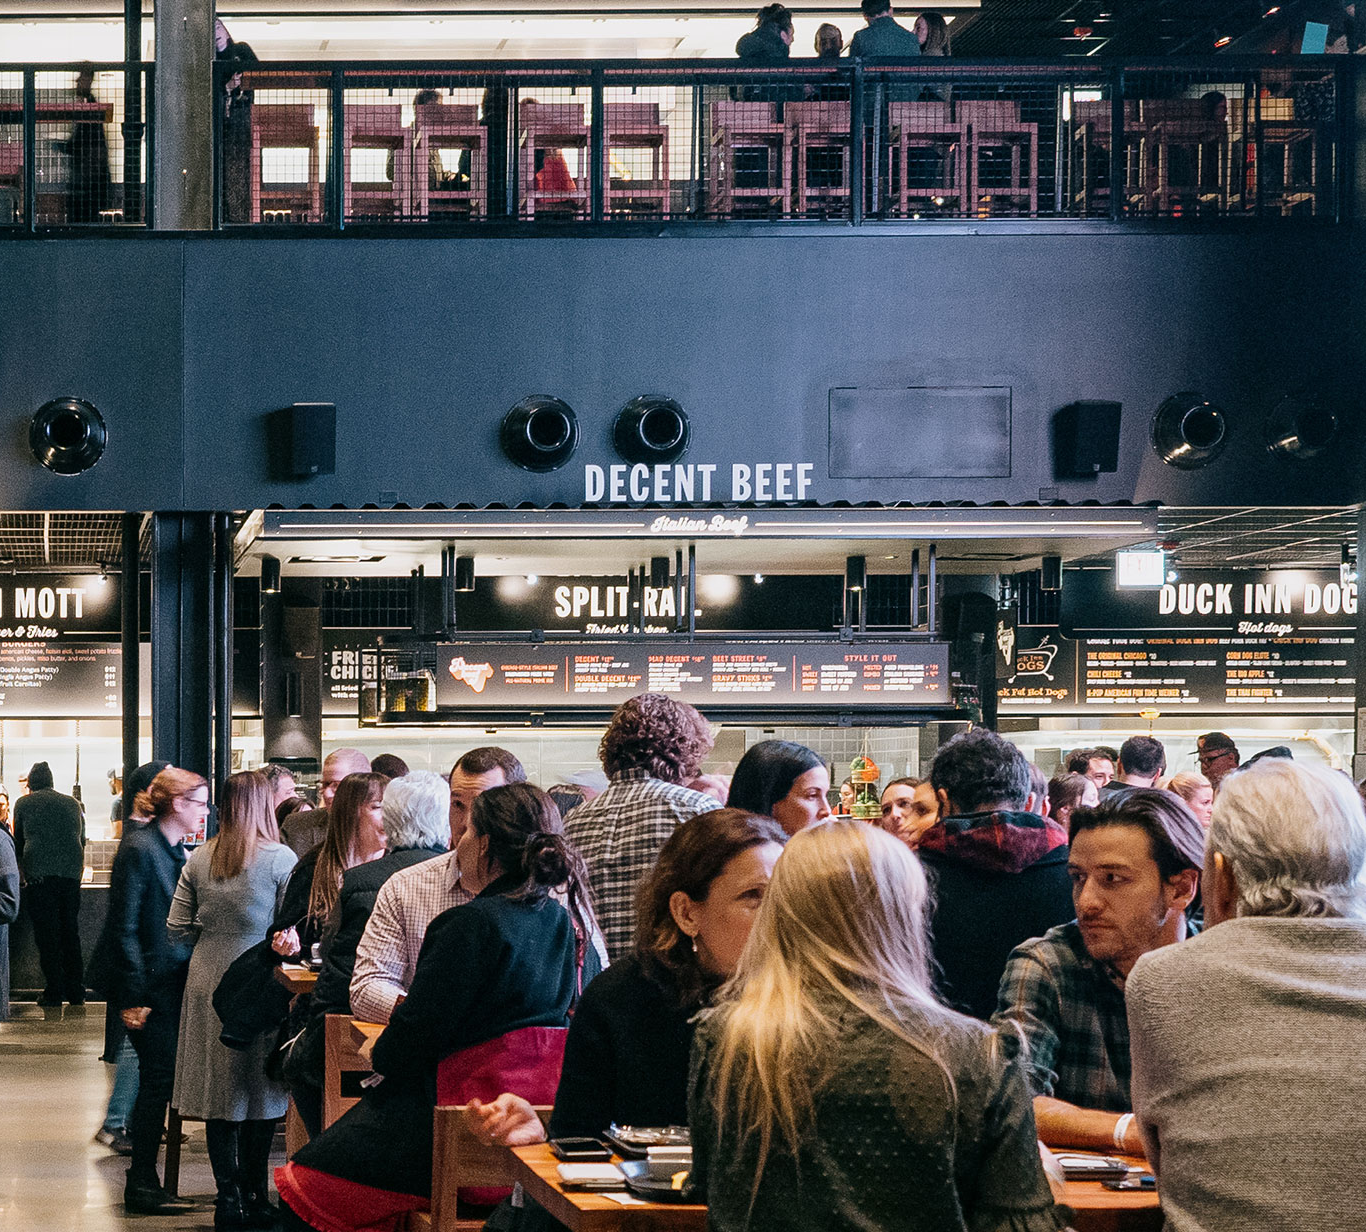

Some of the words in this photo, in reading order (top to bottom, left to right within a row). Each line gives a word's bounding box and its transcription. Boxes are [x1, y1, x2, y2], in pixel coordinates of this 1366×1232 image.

[585, 463, 716, 501] DECENT
[732, 463, 813, 501] BEEF
[650, 515, 707, 536] Italian
[708, 515, 749, 536] Beef
[14, 588, 86, 618] MOTT
[1159, 583, 1233, 614] DUCK
[1244, 583, 1292, 614] INN
[1303, 583, 1358, 614] DOG
[14, 626, 26, 638] &
[26, 625, 59, 638] Fries
[1237, 621, 1263, 635] Hot
[1263, 621, 1294, 636] dogs
[1087, 652, 1097, 660] THE
[1226, 652, 1241, 660] CORN
[1241, 652, 1253, 660] DOG
[21, 666, 40, 674] Angus
[41, 666, 59, 674] Patty)
[1102, 670, 1122, 678] CHEESE
[1248, 670, 1265, 678] APPLE
[1027, 687, 1044, 696] Hot
[1044, 688, 1068, 699] Dogs
